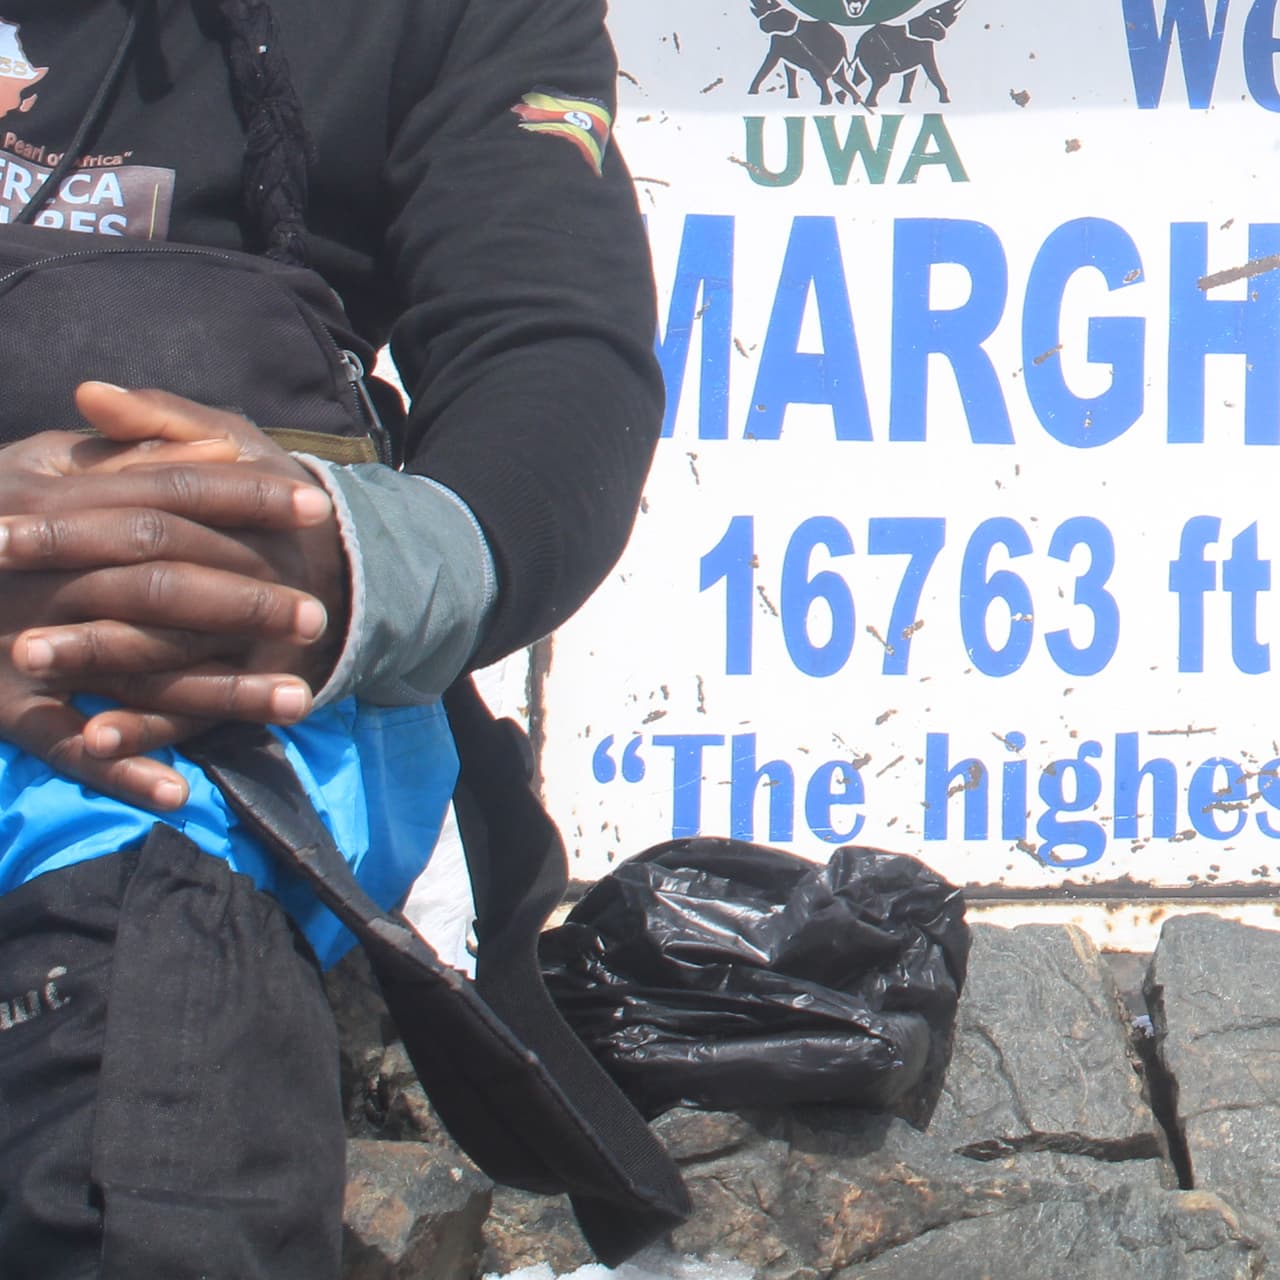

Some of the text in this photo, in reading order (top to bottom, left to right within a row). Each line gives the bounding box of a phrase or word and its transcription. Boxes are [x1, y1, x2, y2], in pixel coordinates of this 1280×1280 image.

[3, 131, 46, 164] Pearl
[743, 113, 970, 187] UWA
[699, 515, 1120, 679] 16763
[1169, 515, 1271, 675] ft
[592, 732, 866, 844] “The
